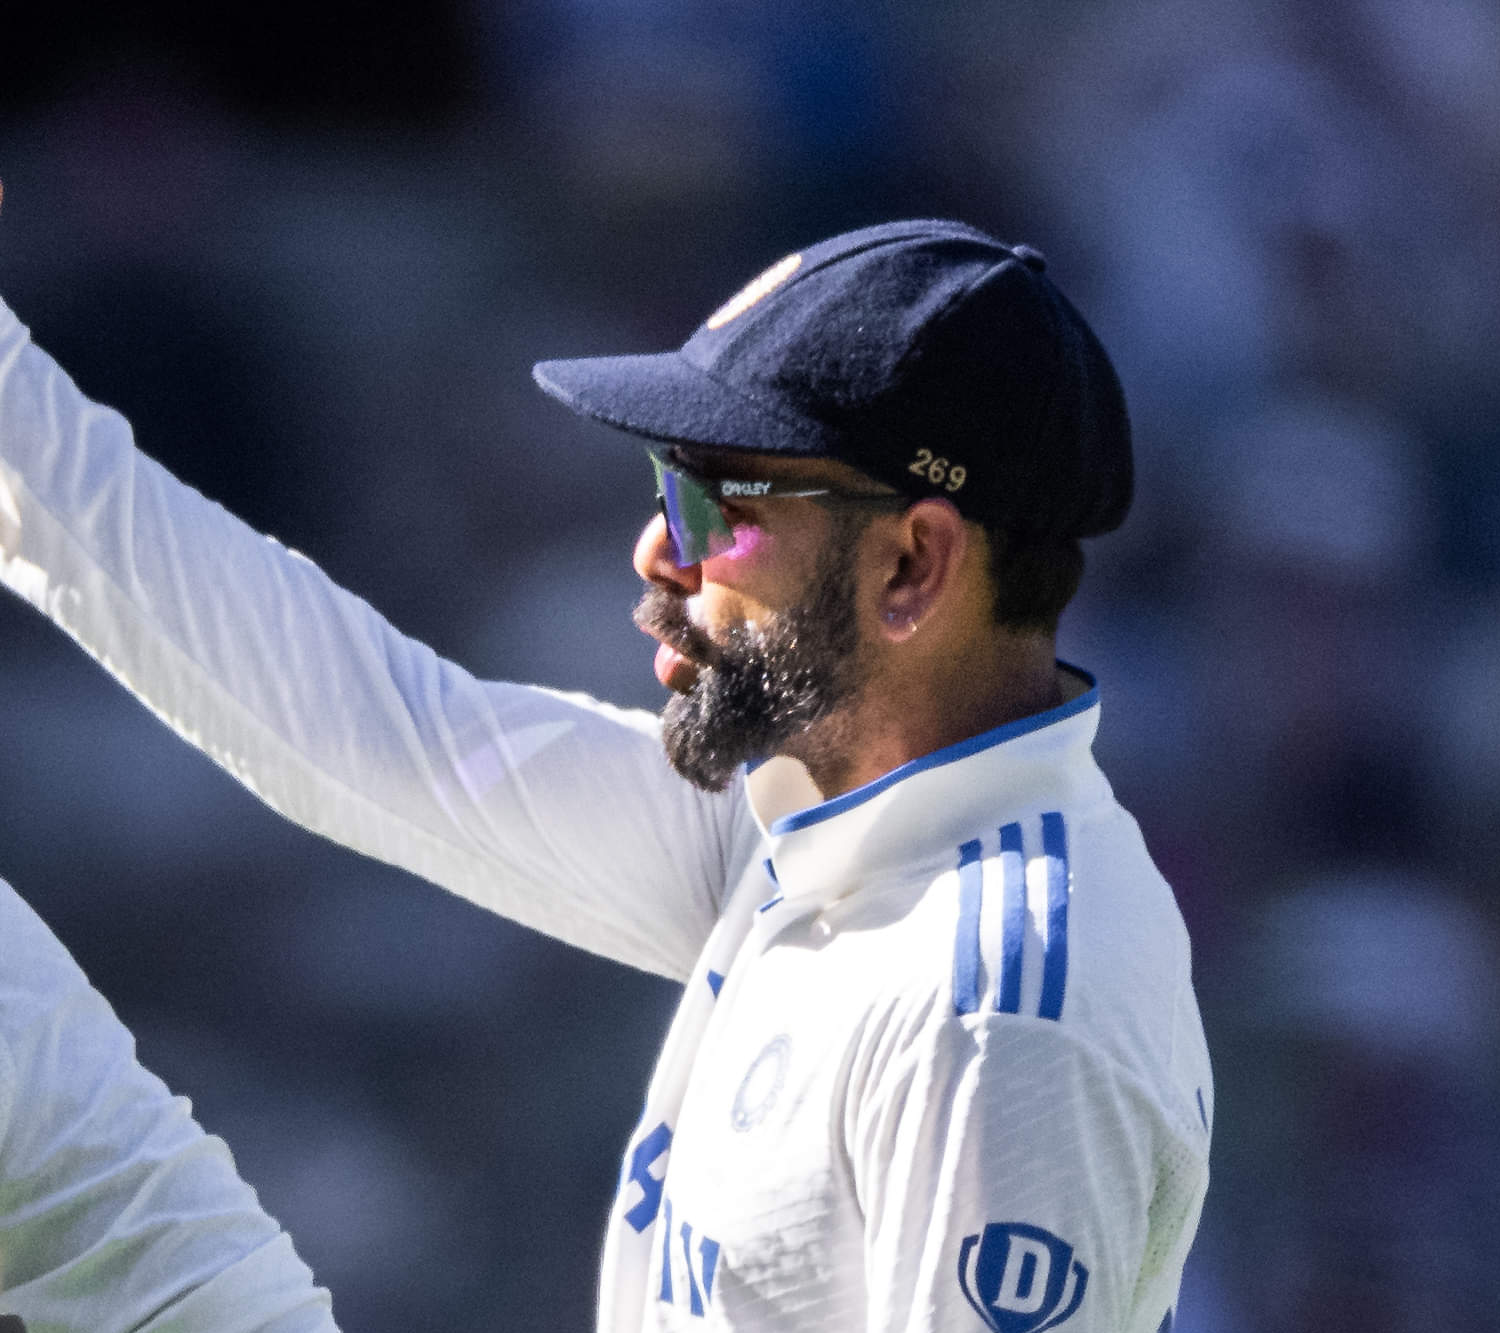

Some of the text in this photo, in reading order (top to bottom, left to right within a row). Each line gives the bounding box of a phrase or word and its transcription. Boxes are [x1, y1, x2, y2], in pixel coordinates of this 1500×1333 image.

[721, 480, 772, 496] OAKLEY
[908, 448, 967, 492] 269
[991, 1234, 1052, 1314] D
